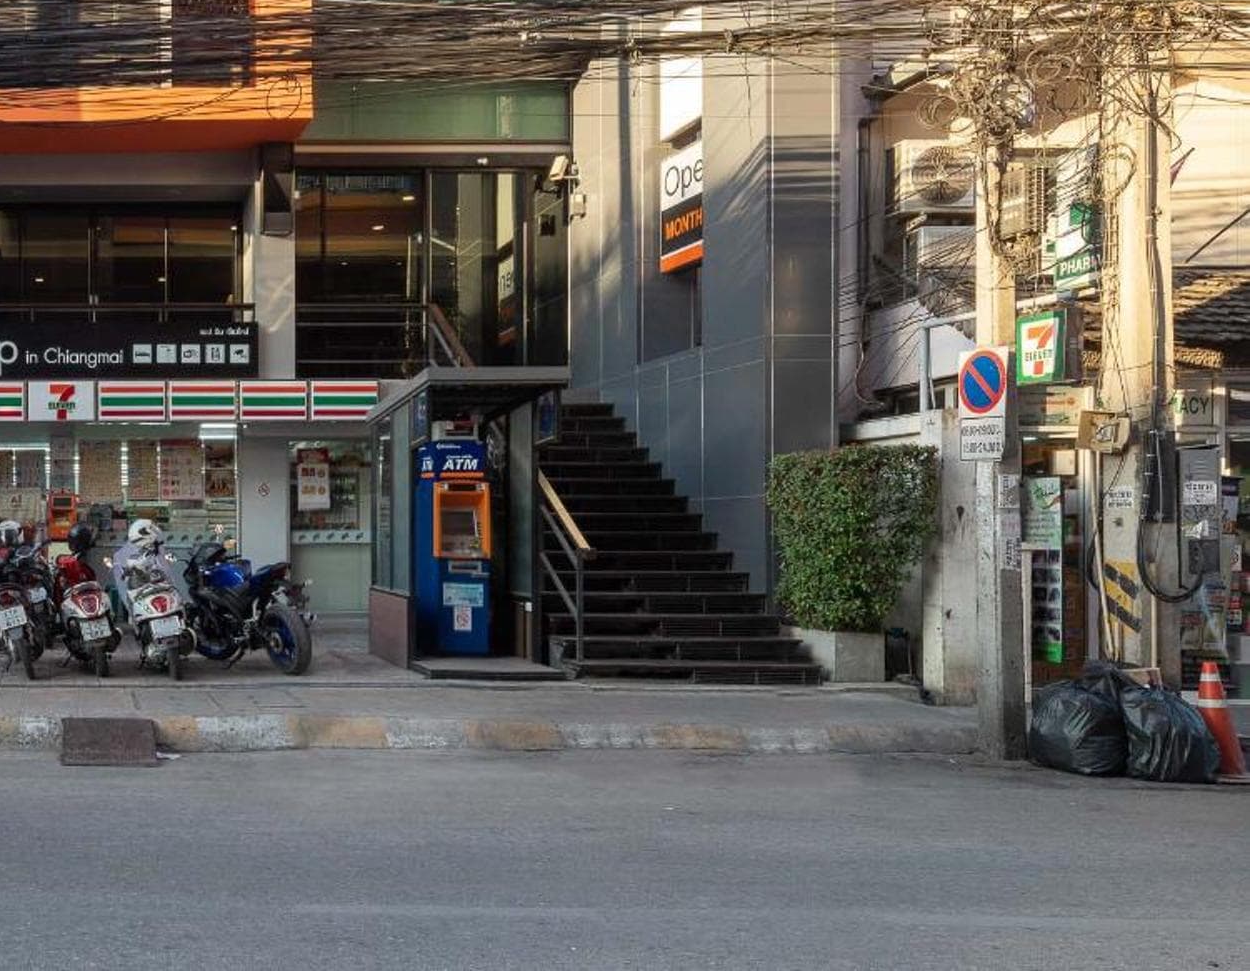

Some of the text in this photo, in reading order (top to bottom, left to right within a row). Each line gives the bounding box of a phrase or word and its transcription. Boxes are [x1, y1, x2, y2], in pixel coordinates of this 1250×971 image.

[1057, 254, 1101, 277] PHAR
[25, 349, 38, 365] in
[44, 347, 124, 368] Chiangmai
[442, 458, 479, 471] ATM
